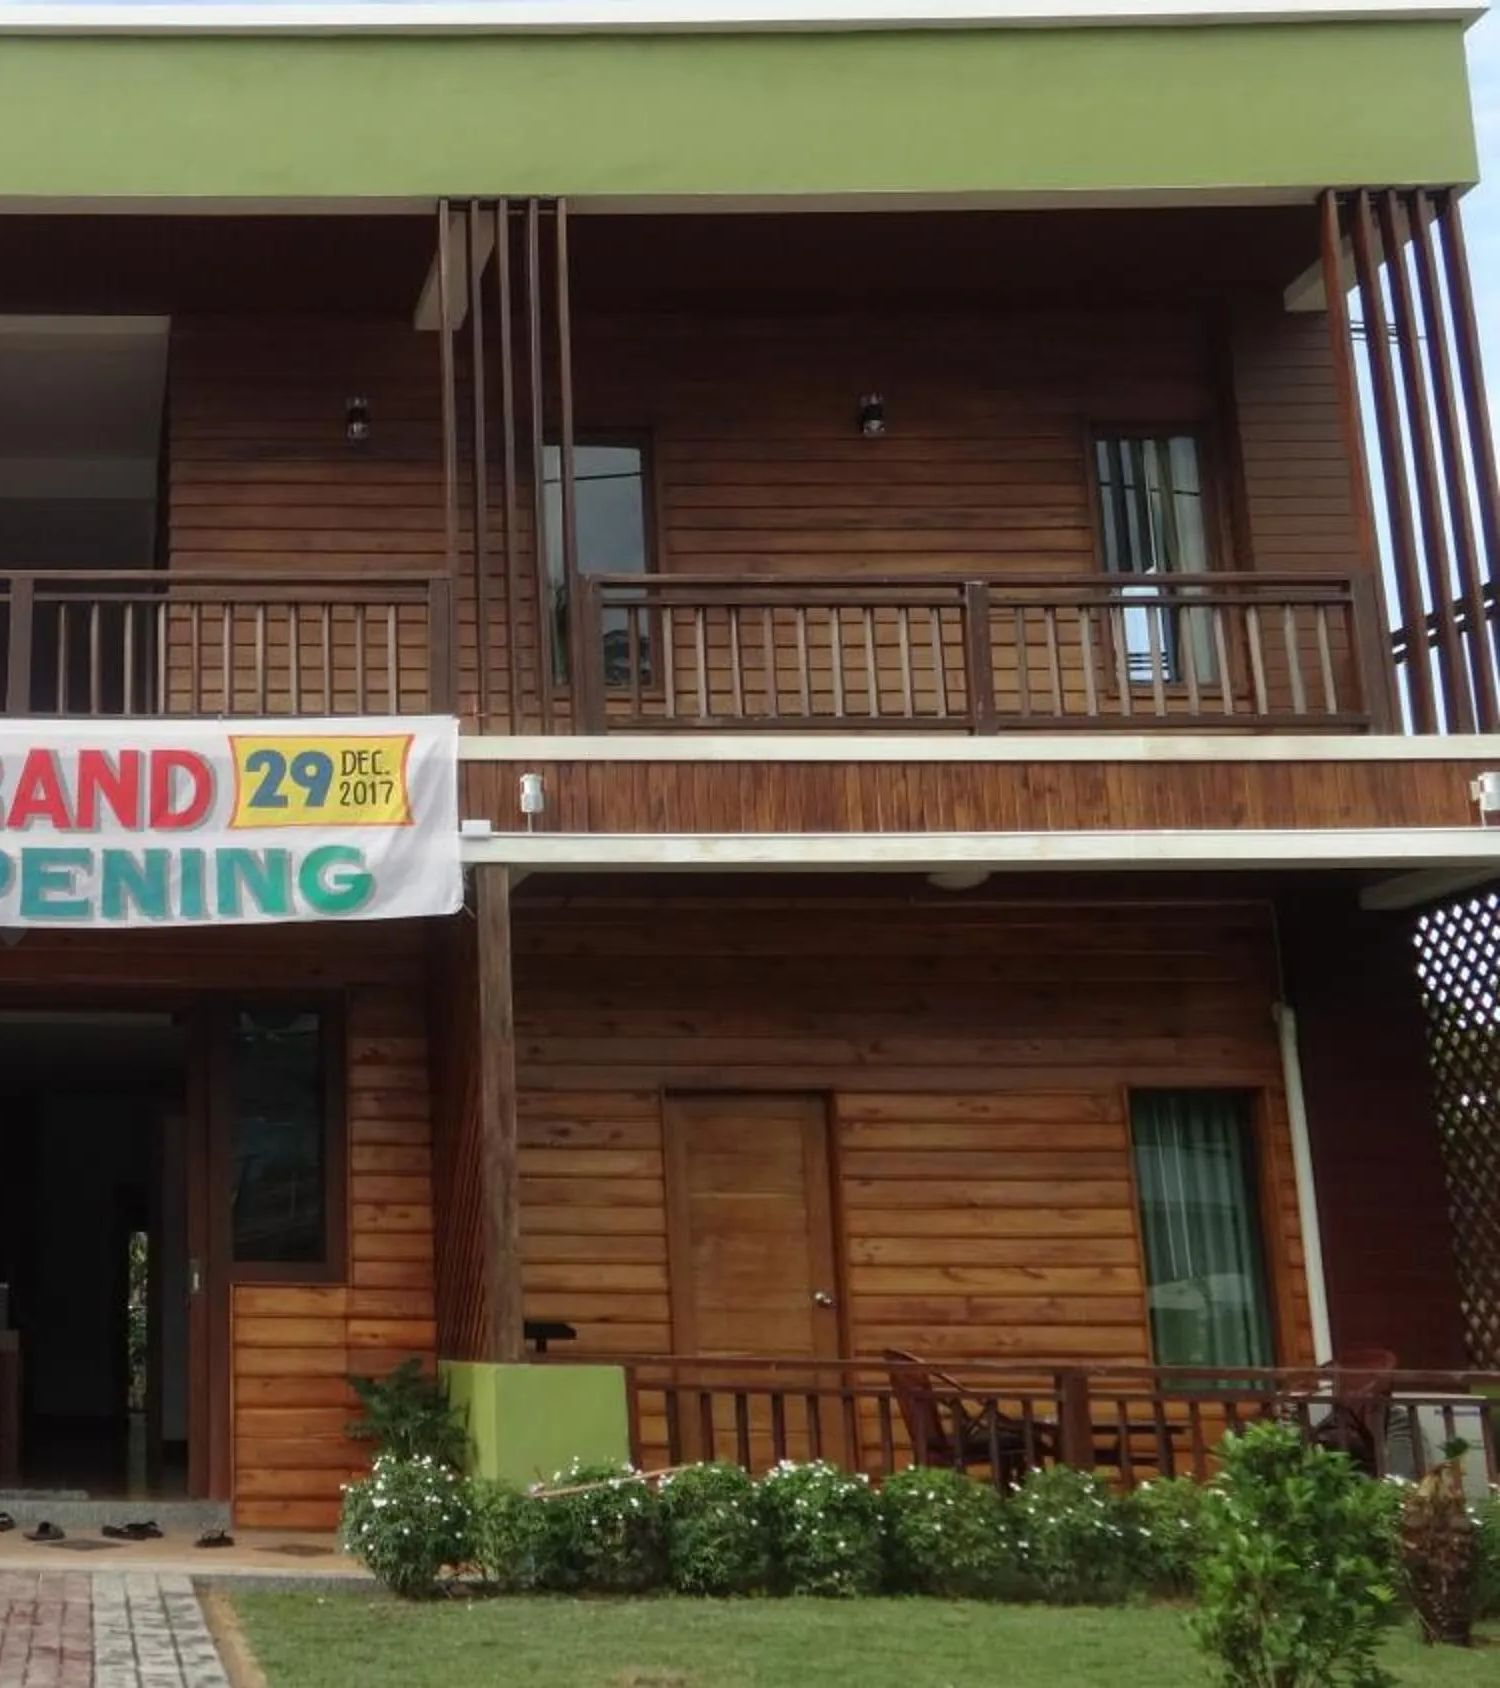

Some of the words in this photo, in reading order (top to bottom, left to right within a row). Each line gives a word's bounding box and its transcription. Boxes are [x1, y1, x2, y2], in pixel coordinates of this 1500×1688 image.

[340, 749, 391, 777] DEC.
[244, 749, 334, 808] 29
[339, 780, 395, 806] 2017
